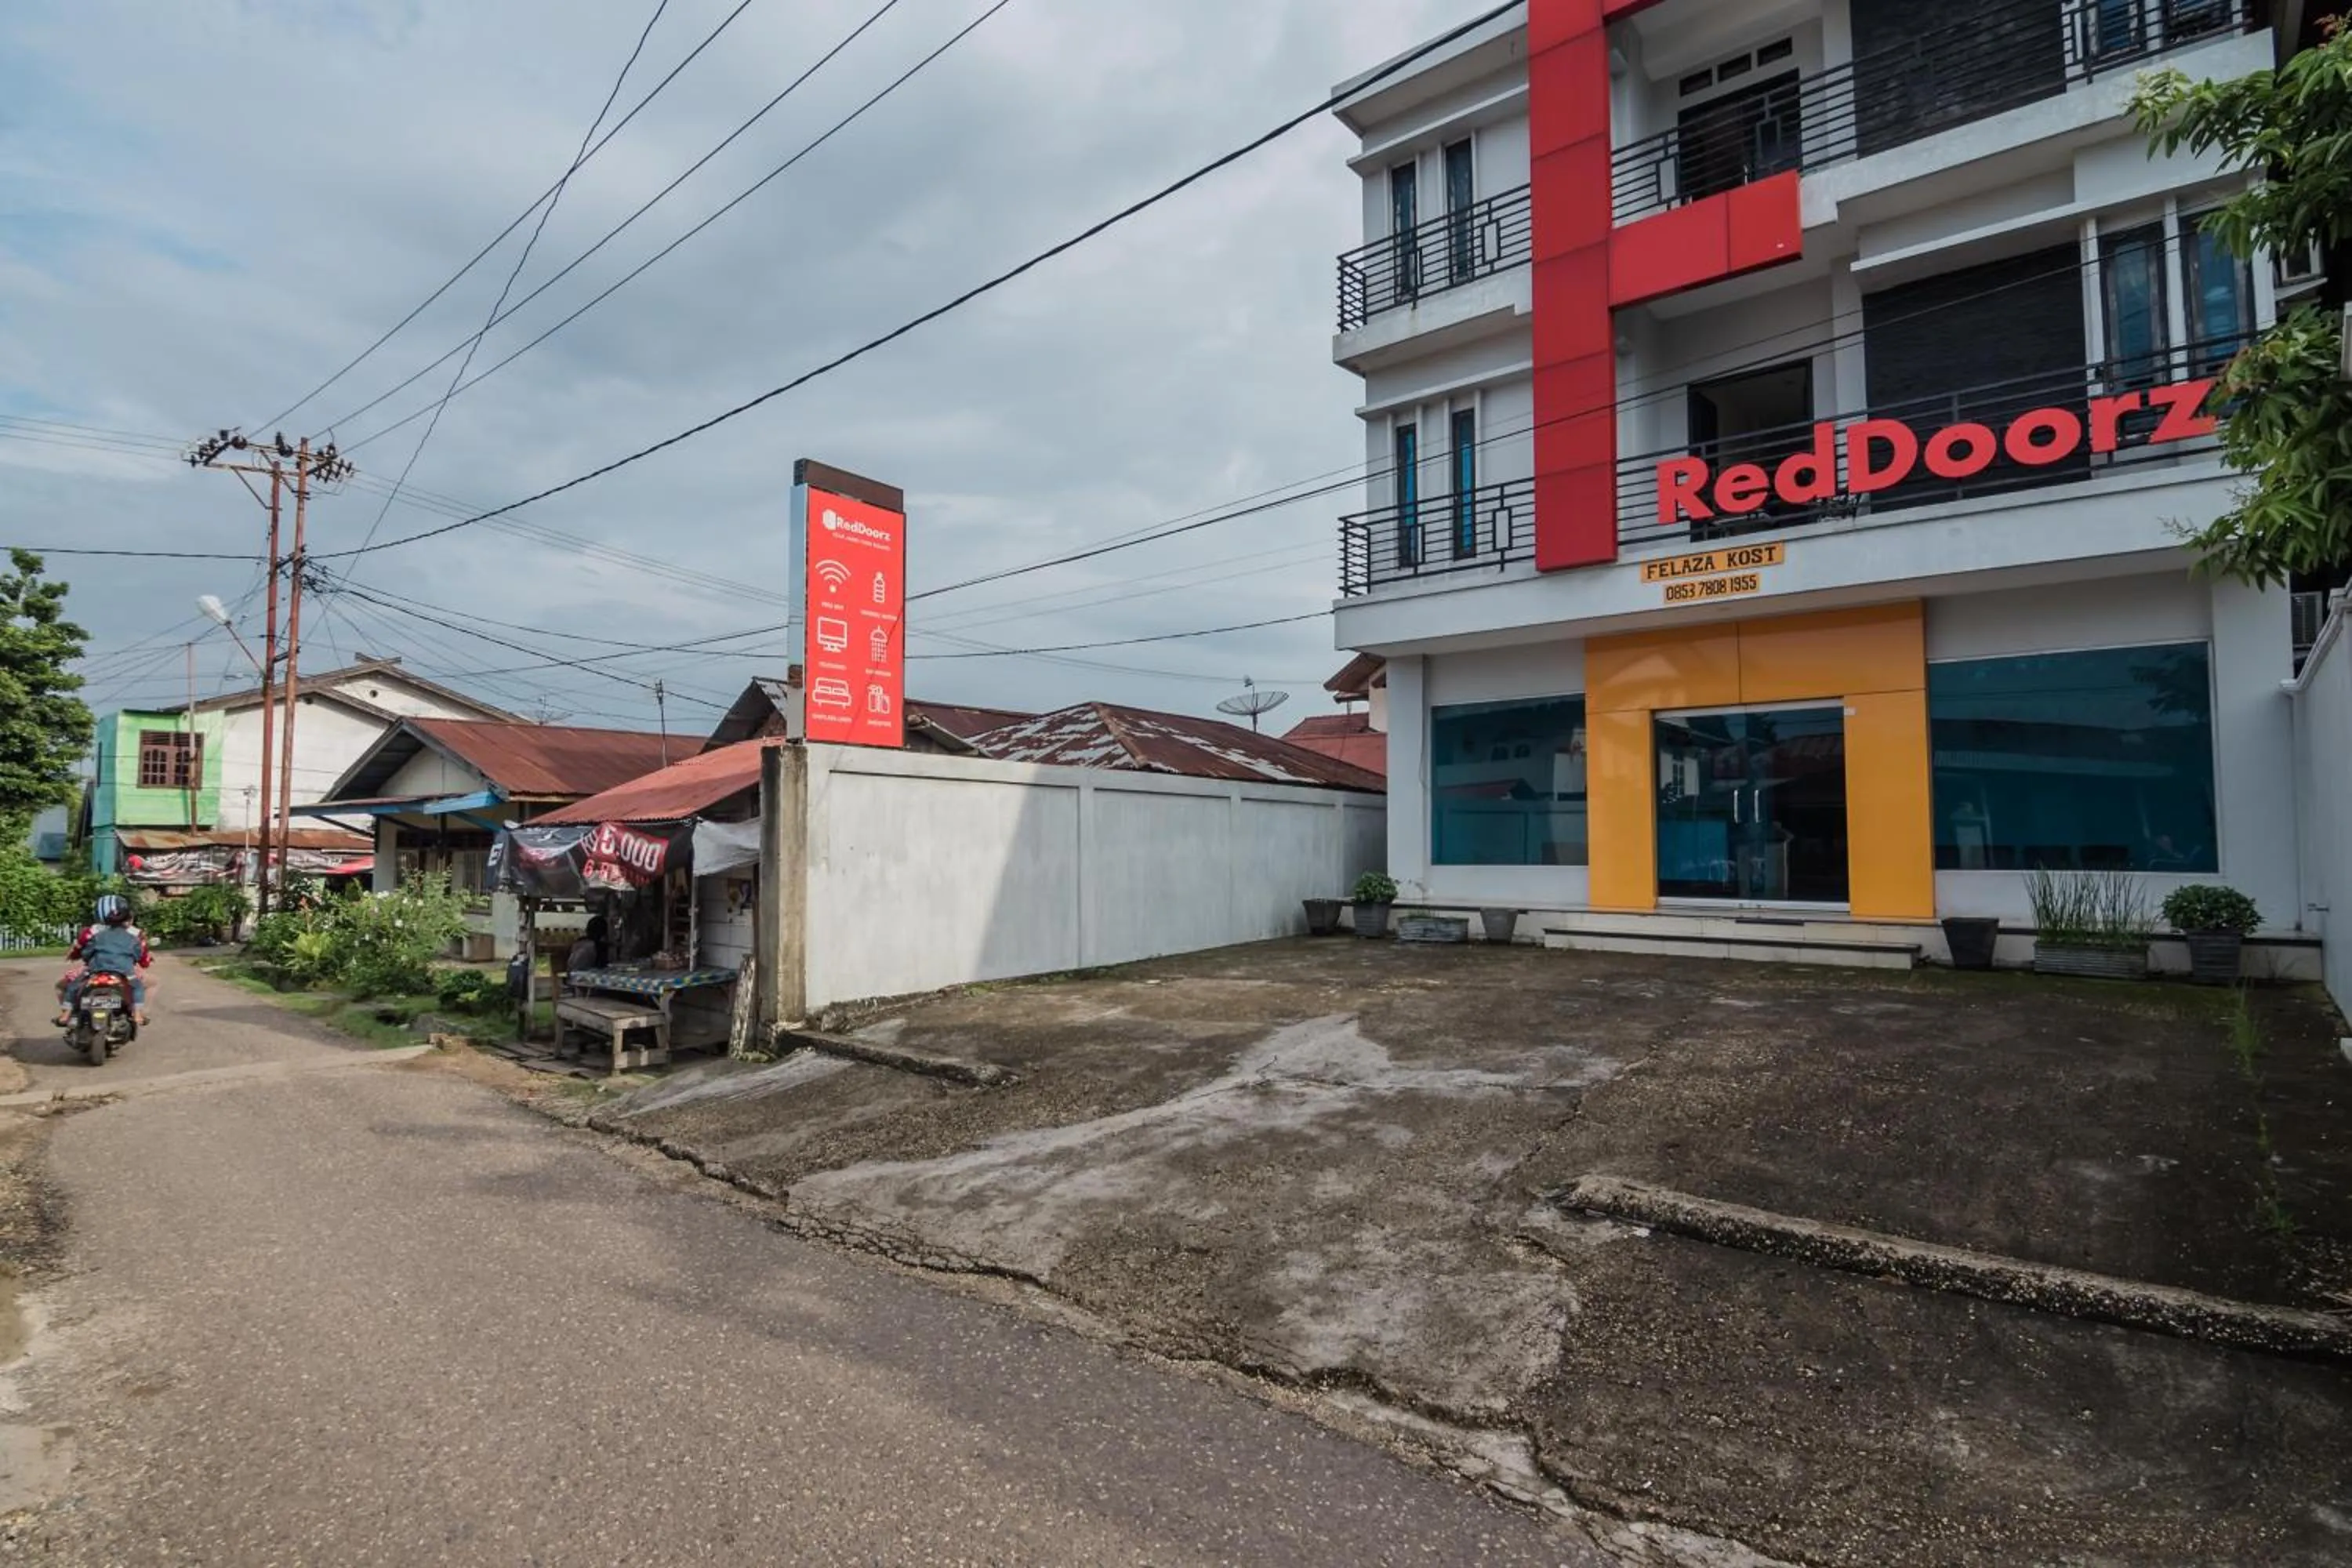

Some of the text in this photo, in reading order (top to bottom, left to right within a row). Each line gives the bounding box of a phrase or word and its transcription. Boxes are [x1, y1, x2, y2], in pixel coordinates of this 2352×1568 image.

[1656, 378, 2216, 524] RedDoorz
[837, 516, 891, 541] RedDoorz
[1646, 546, 1777, 579] FELAZA KOST
[1665, 574, 1757, 601] 0853 7808 1955
